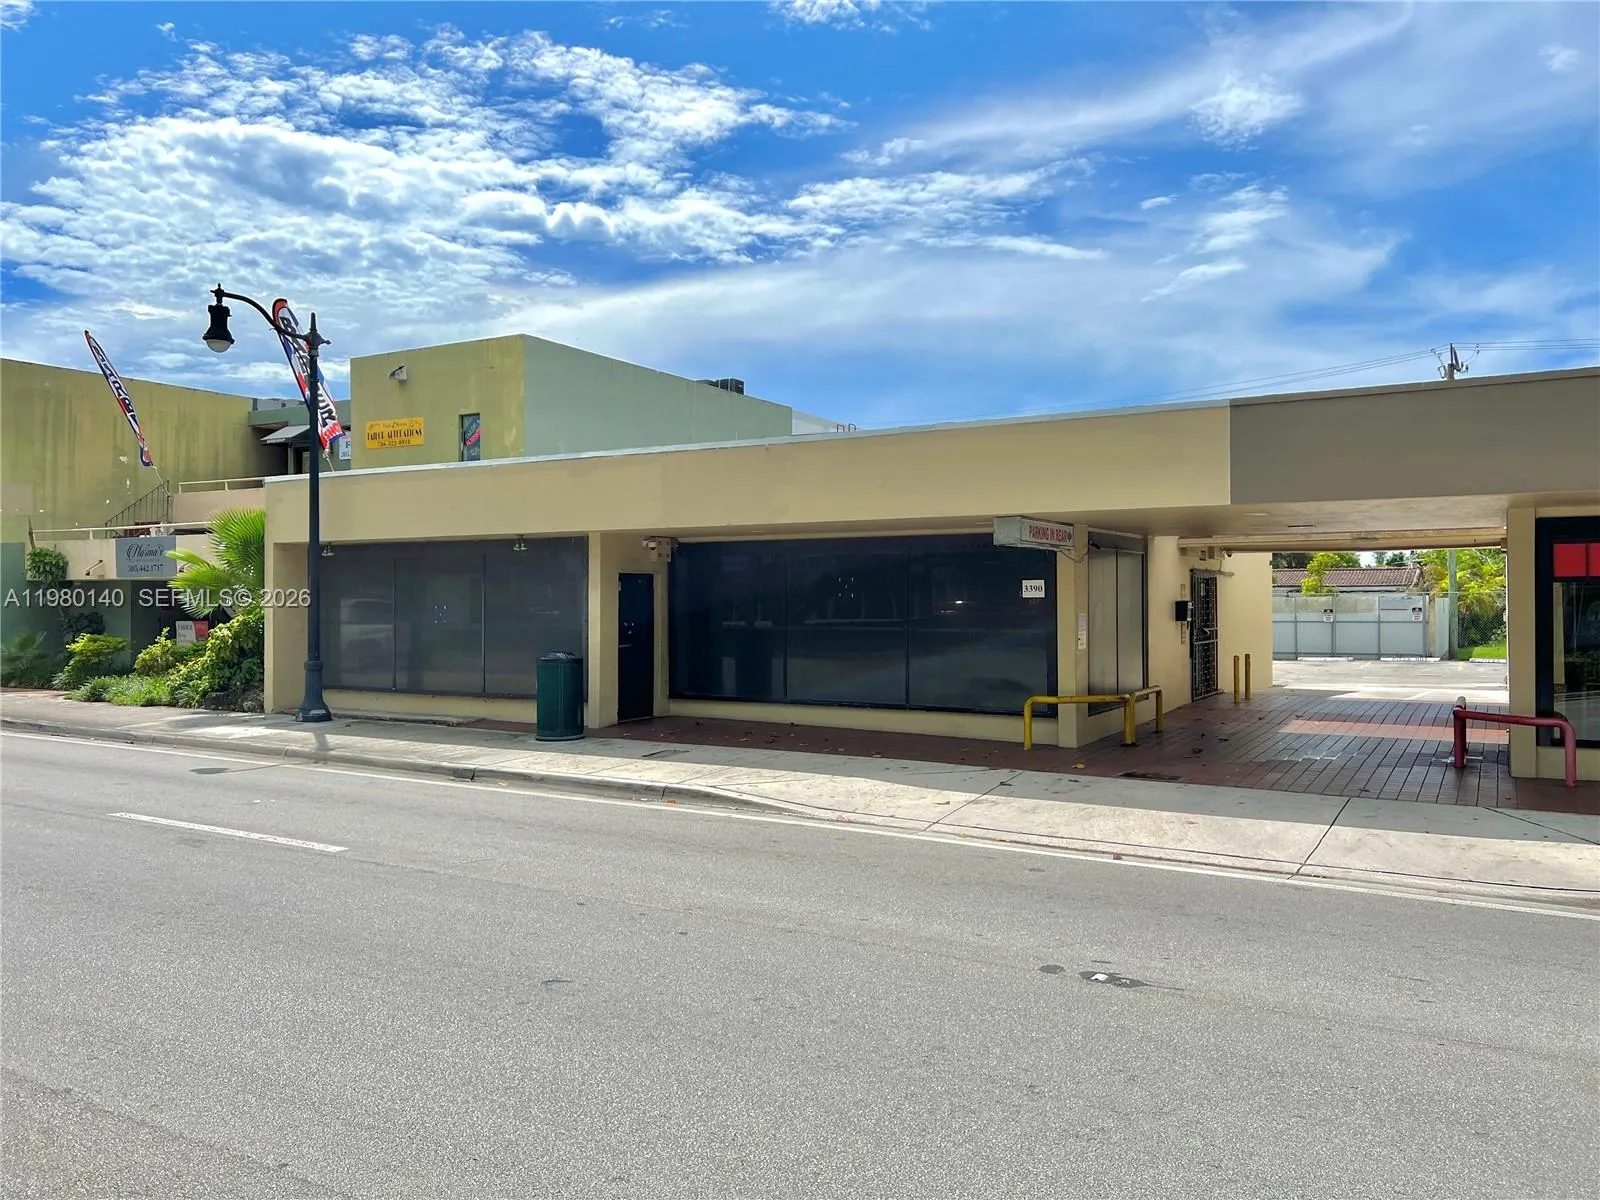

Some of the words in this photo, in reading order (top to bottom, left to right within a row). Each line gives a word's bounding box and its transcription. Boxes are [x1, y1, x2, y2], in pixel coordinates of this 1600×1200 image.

[324, 421, 341, 438] SHO
[1029, 525, 1050, 541] PARKING
[1050, 528, 1056, 541] IN
[1056, 528, 1068, 543] REAR
[1024, 585, 1043, 593] 3390
